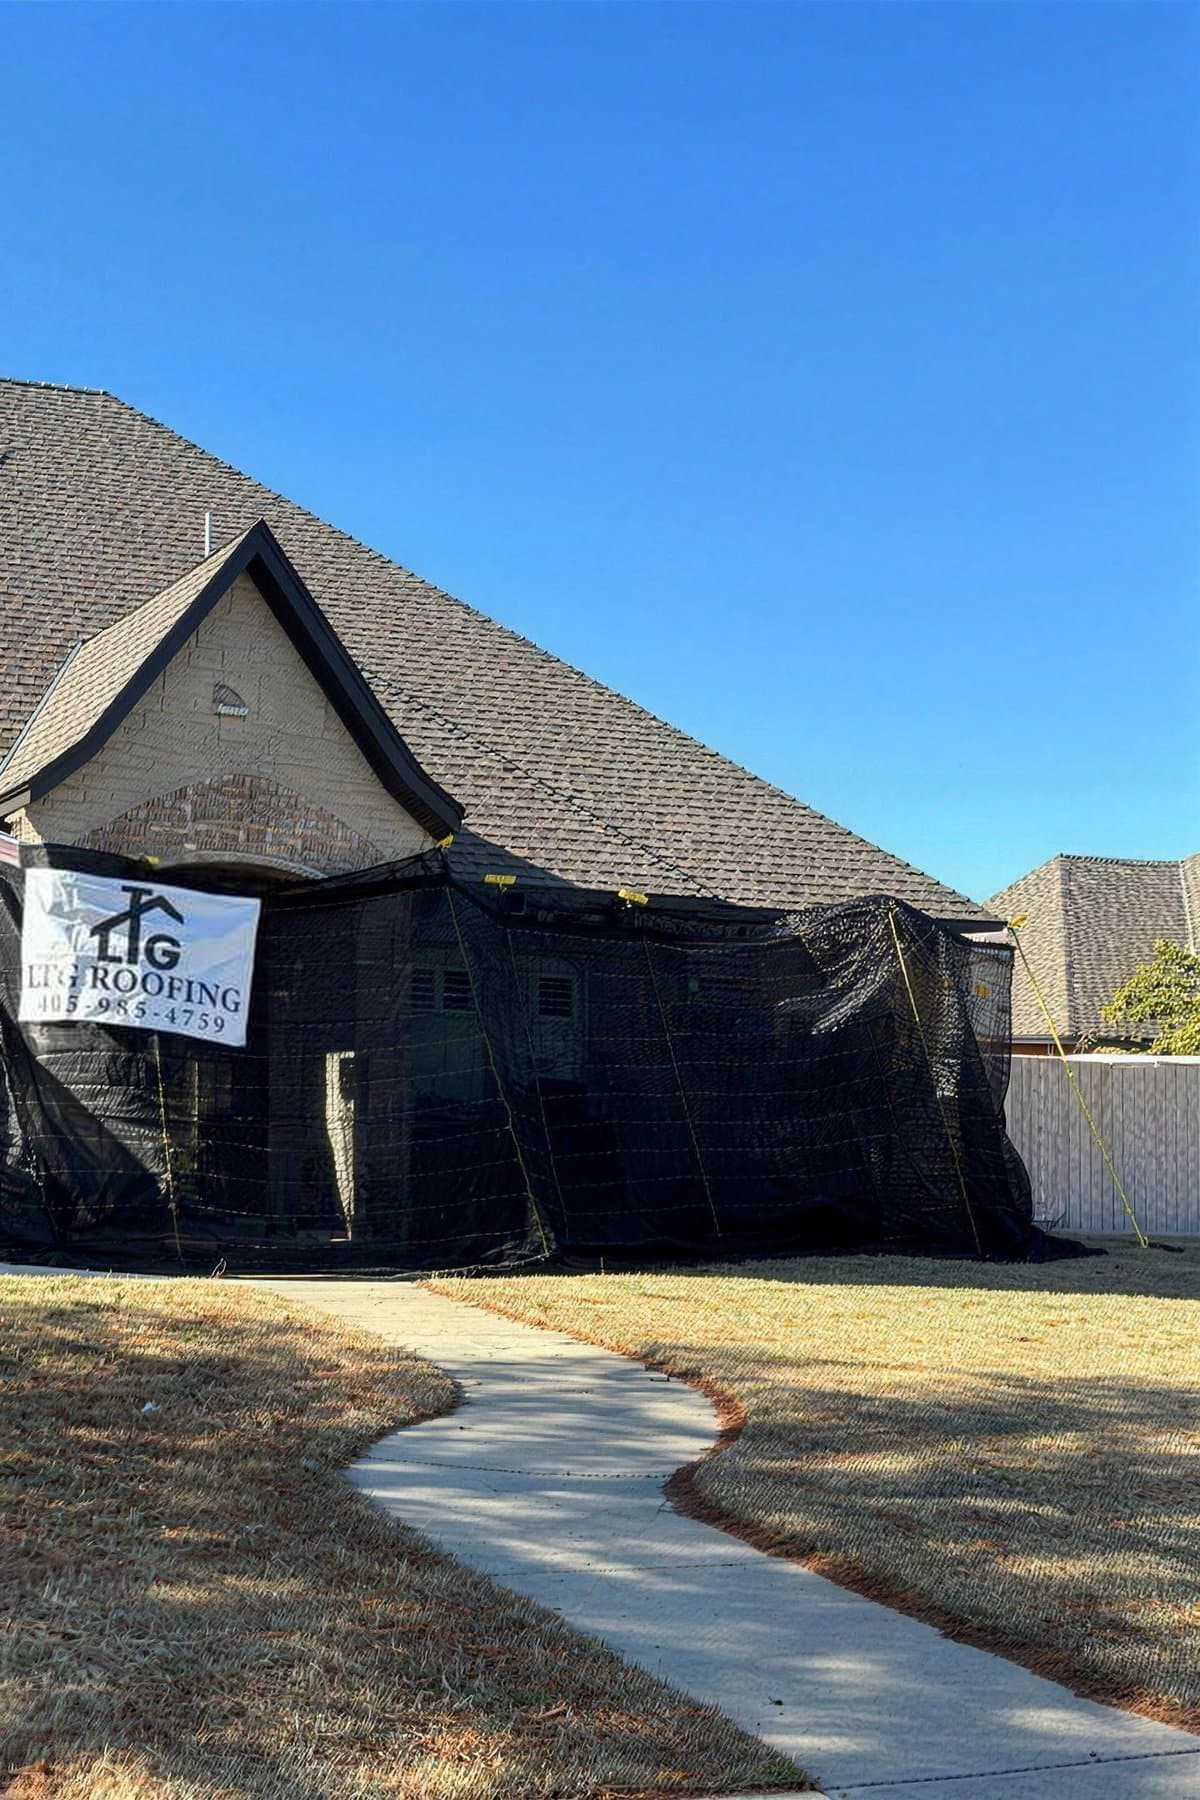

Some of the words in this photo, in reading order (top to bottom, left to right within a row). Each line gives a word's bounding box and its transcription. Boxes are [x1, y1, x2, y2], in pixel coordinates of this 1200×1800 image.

[91, 885, 184, 970] LTG
[28, 964, 80, 989] LTG
[91, 965, 241, 1013] ROOFING
